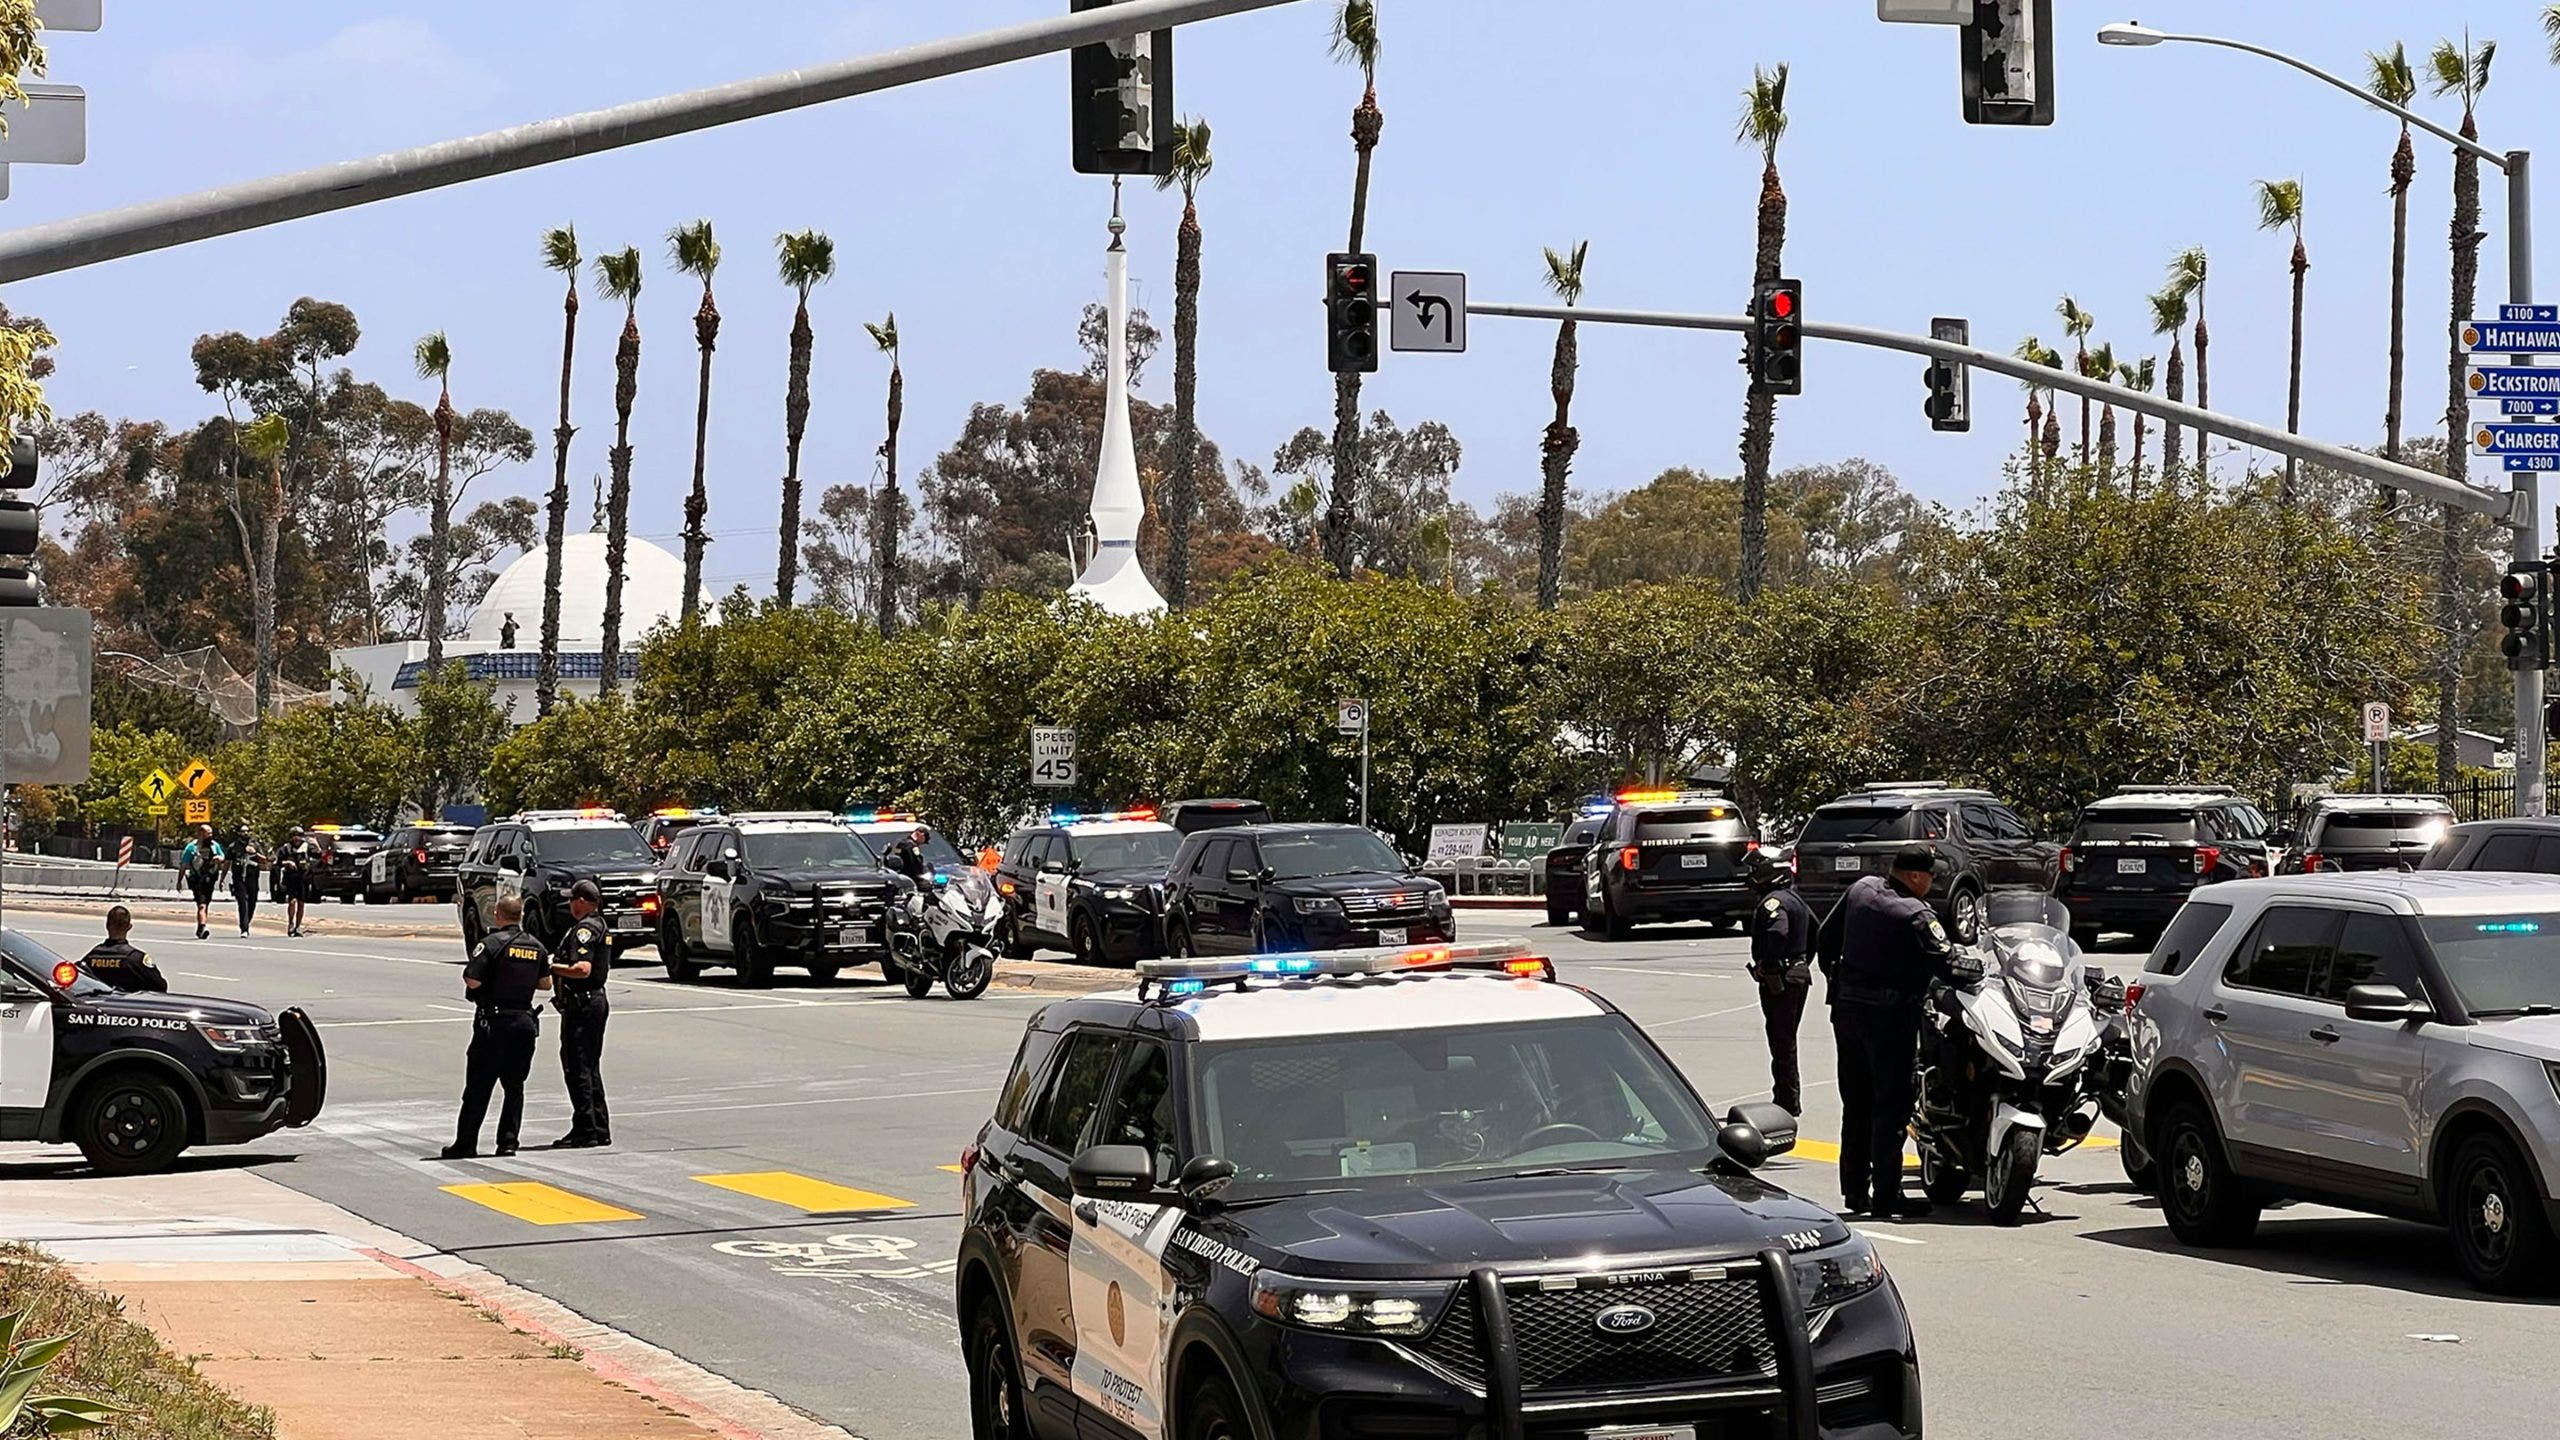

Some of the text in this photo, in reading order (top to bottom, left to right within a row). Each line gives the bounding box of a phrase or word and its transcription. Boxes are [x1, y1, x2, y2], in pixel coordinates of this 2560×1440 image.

[2506, 307, 2534, 320] 4100
[2488, 373, 2560, 393] ECKSTROM
[2507, 400, 2534, 413] 7000
[2495, 429, 2559, 449] CHARGER
[2527, 457, 2553, 469] 4300
[1035, 732, 1075, 742] SPEED
[1038, 745, 1072, 756] LIMIT
[1036, 759, 1073, 780] 45
[189, 801, 207, 813] 35
[1508, 835, 1556, 849] YOUR AD HERE
[509, 946, 538, 961] POLICE
[90, 958, 121, 968] POLICE
[0, 1009, 21, 1019] EST
[68, 1013, 188, 1032] SAN DIEGO POLICE
[1171, 1227, 1260, 1277] SAN DIEGO POLICE
[1607, 1272, 1665, 1285] SETINA
[1610, 1312, 1642, 1327] Ford
[1100, 1369, 1143, 1404] TO PROTECT
